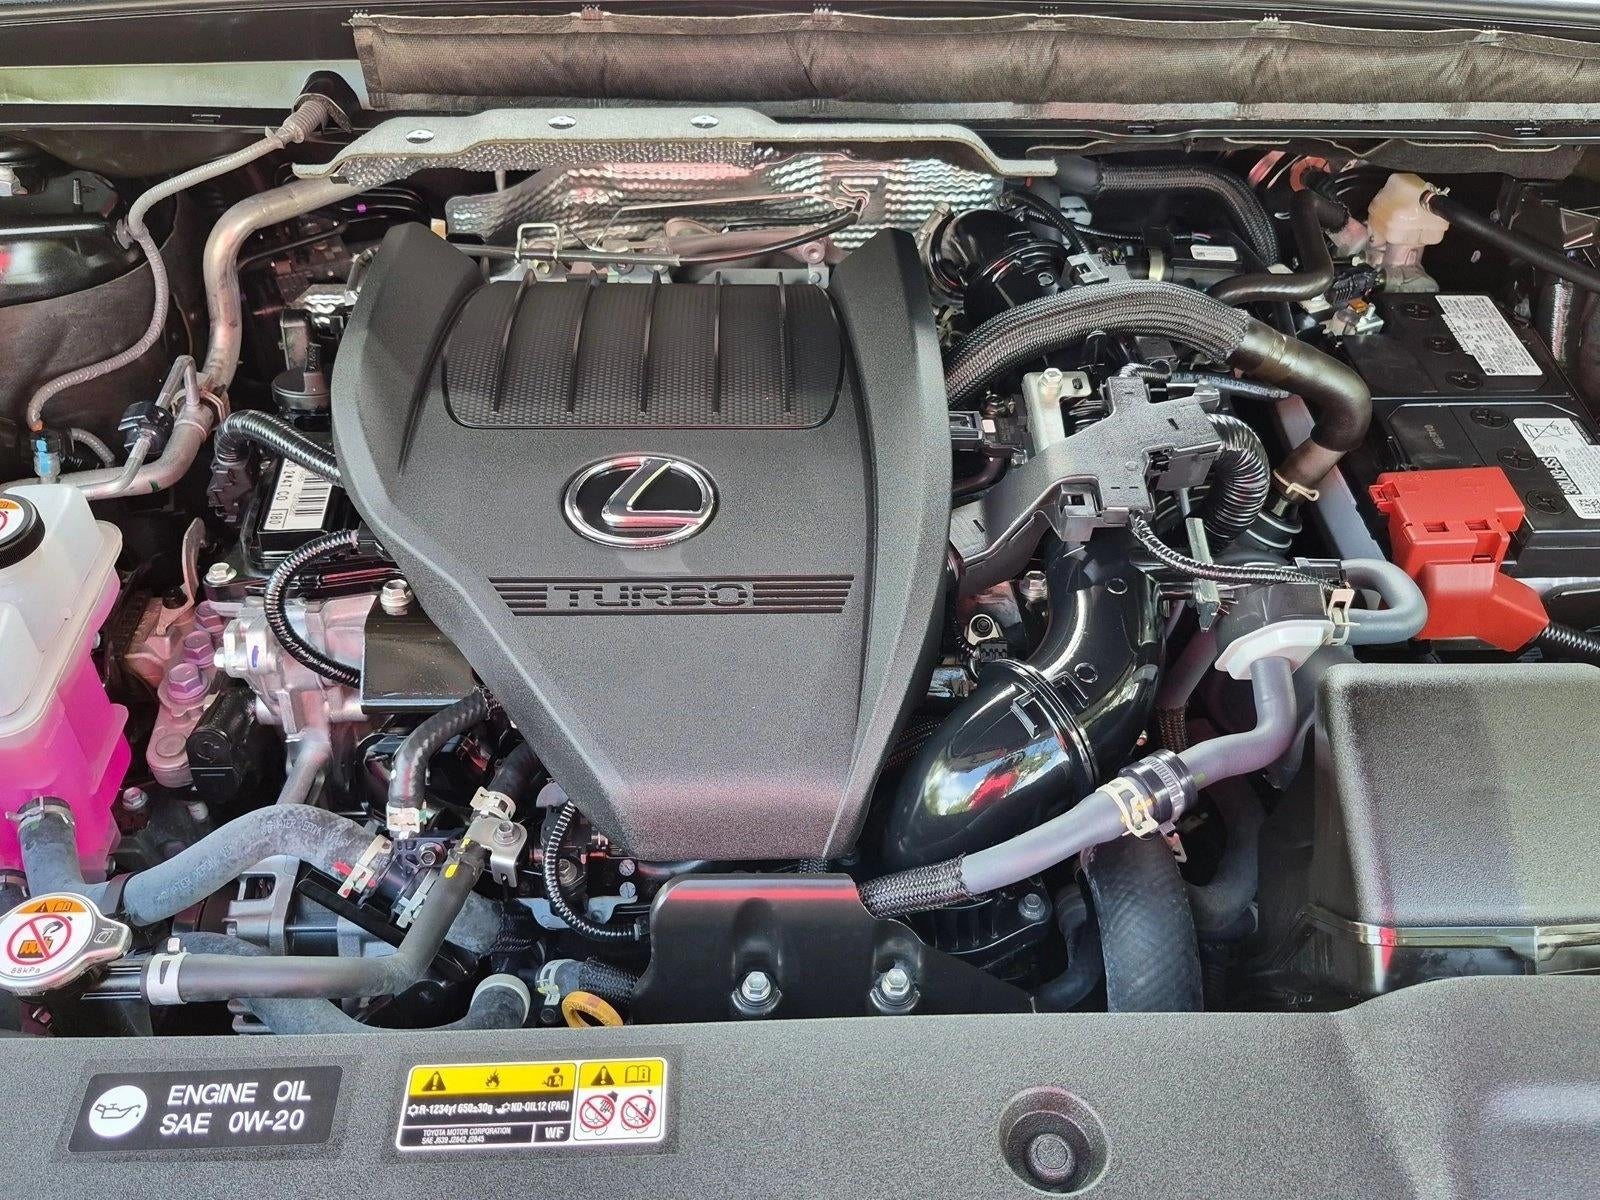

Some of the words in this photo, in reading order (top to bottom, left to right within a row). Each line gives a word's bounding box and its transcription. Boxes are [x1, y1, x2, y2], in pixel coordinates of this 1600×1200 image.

[268, 512, 283, 525] 180
[553, 583, 749, 607] TURBO
[166, 1082, 259, 1106] ENGINE
[273, 1080, 312, 1102] OIL
[419, 1104, 457, 1116] R-1234yf
[510, 1101, 547, 1113] ND-OIL12
[547, 1100, 570, 1113] (PAG)
[159, 1113, 212, 1136] SAE
[228, 1109, 305, 1133] 0W-20
[423, 1129, 446, 1137] TOYOTA
[446, 1128, 469, 1136] MOTOR
[469, 1127, 512, 1136] CORPORATION
[544, 1126, 565, 1139] WF
[421, 1137, 434, 1145] SAE
